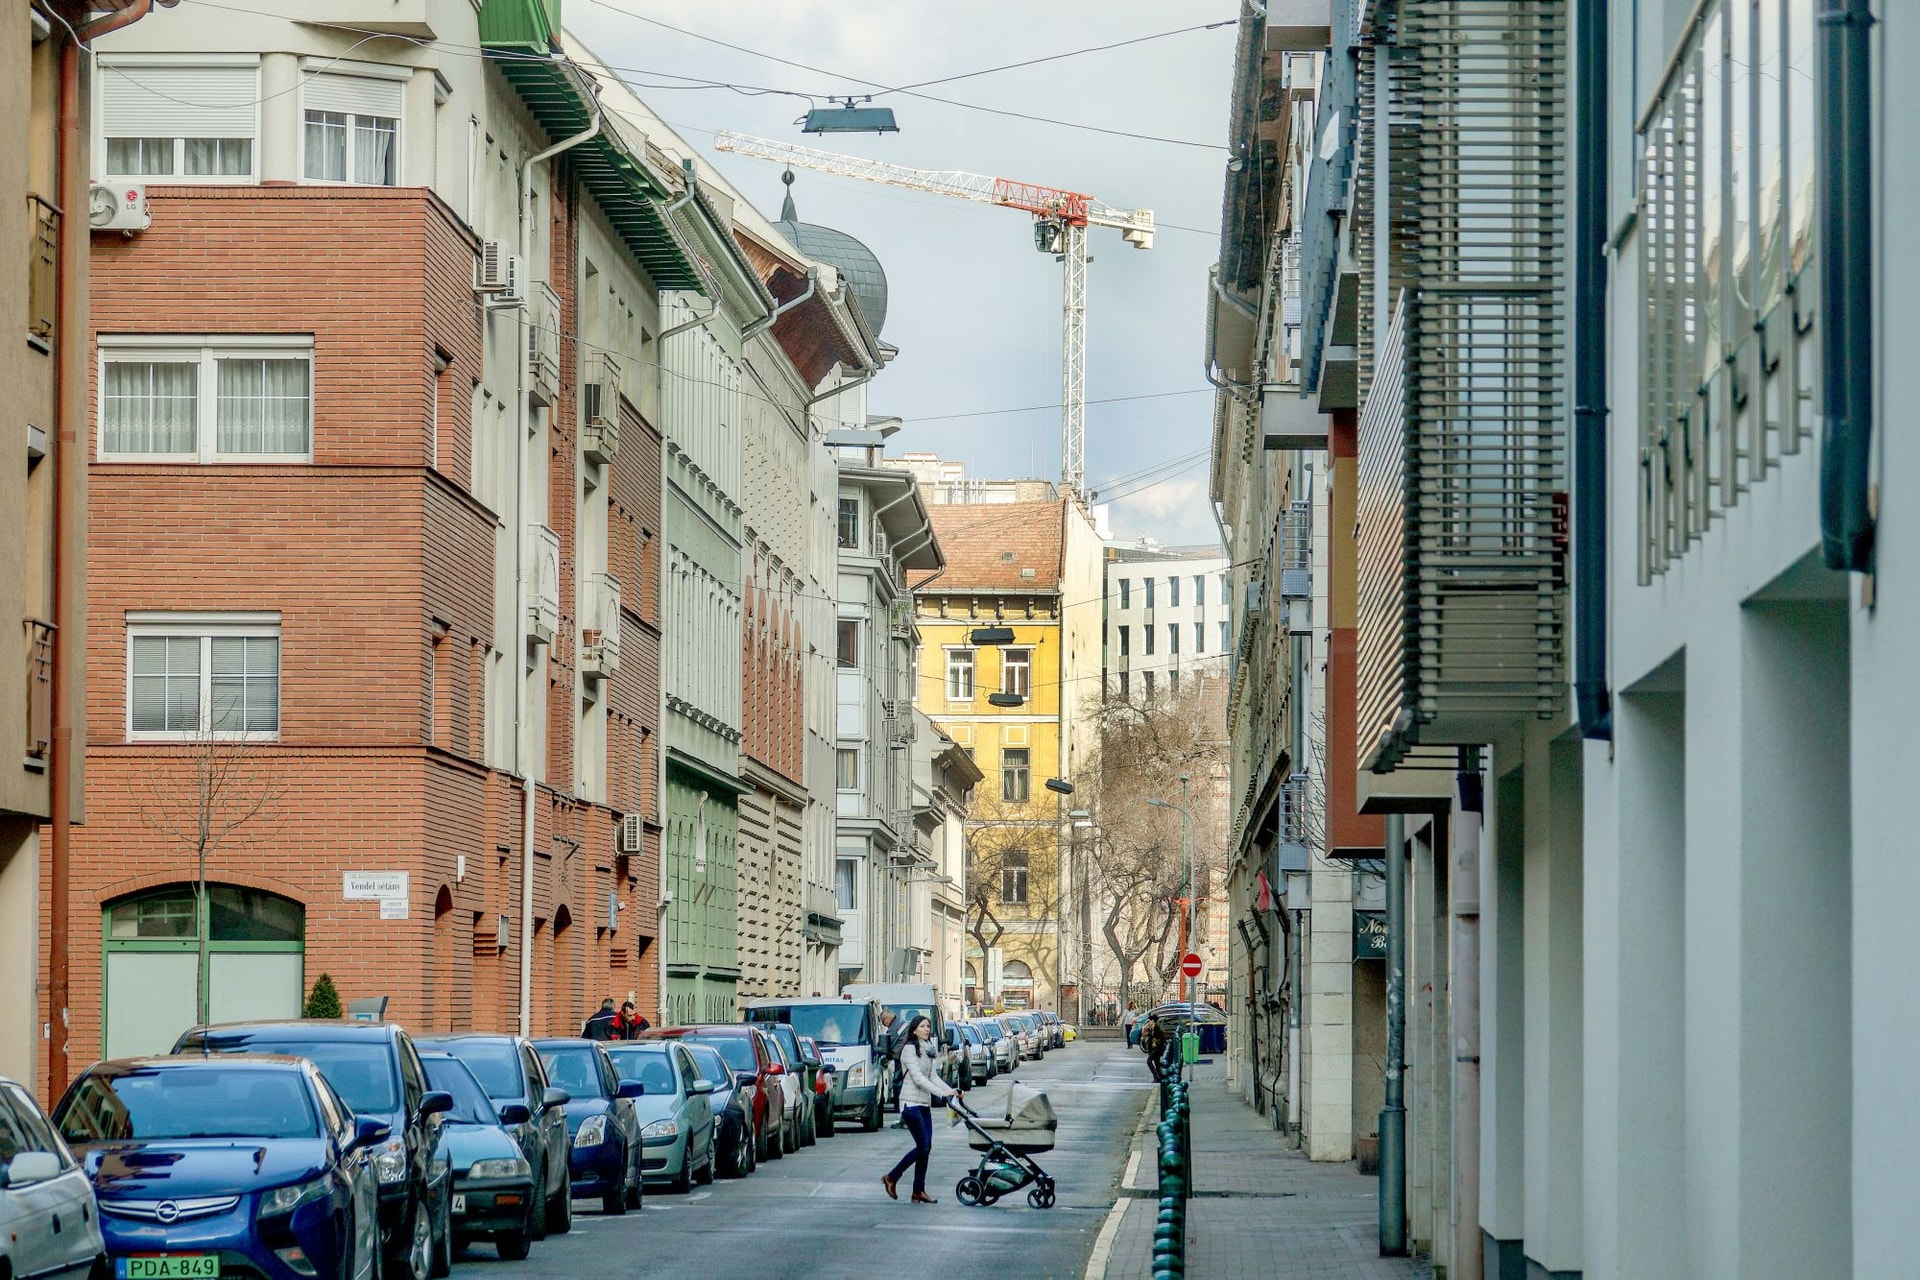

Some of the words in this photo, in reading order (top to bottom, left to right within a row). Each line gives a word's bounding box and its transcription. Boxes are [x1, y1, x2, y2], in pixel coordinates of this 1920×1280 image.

[350, 881, 376, 890] Vendel
[377, 881, 401, 892] sétány
[130, 1259, 214, 1277] PDA-849
